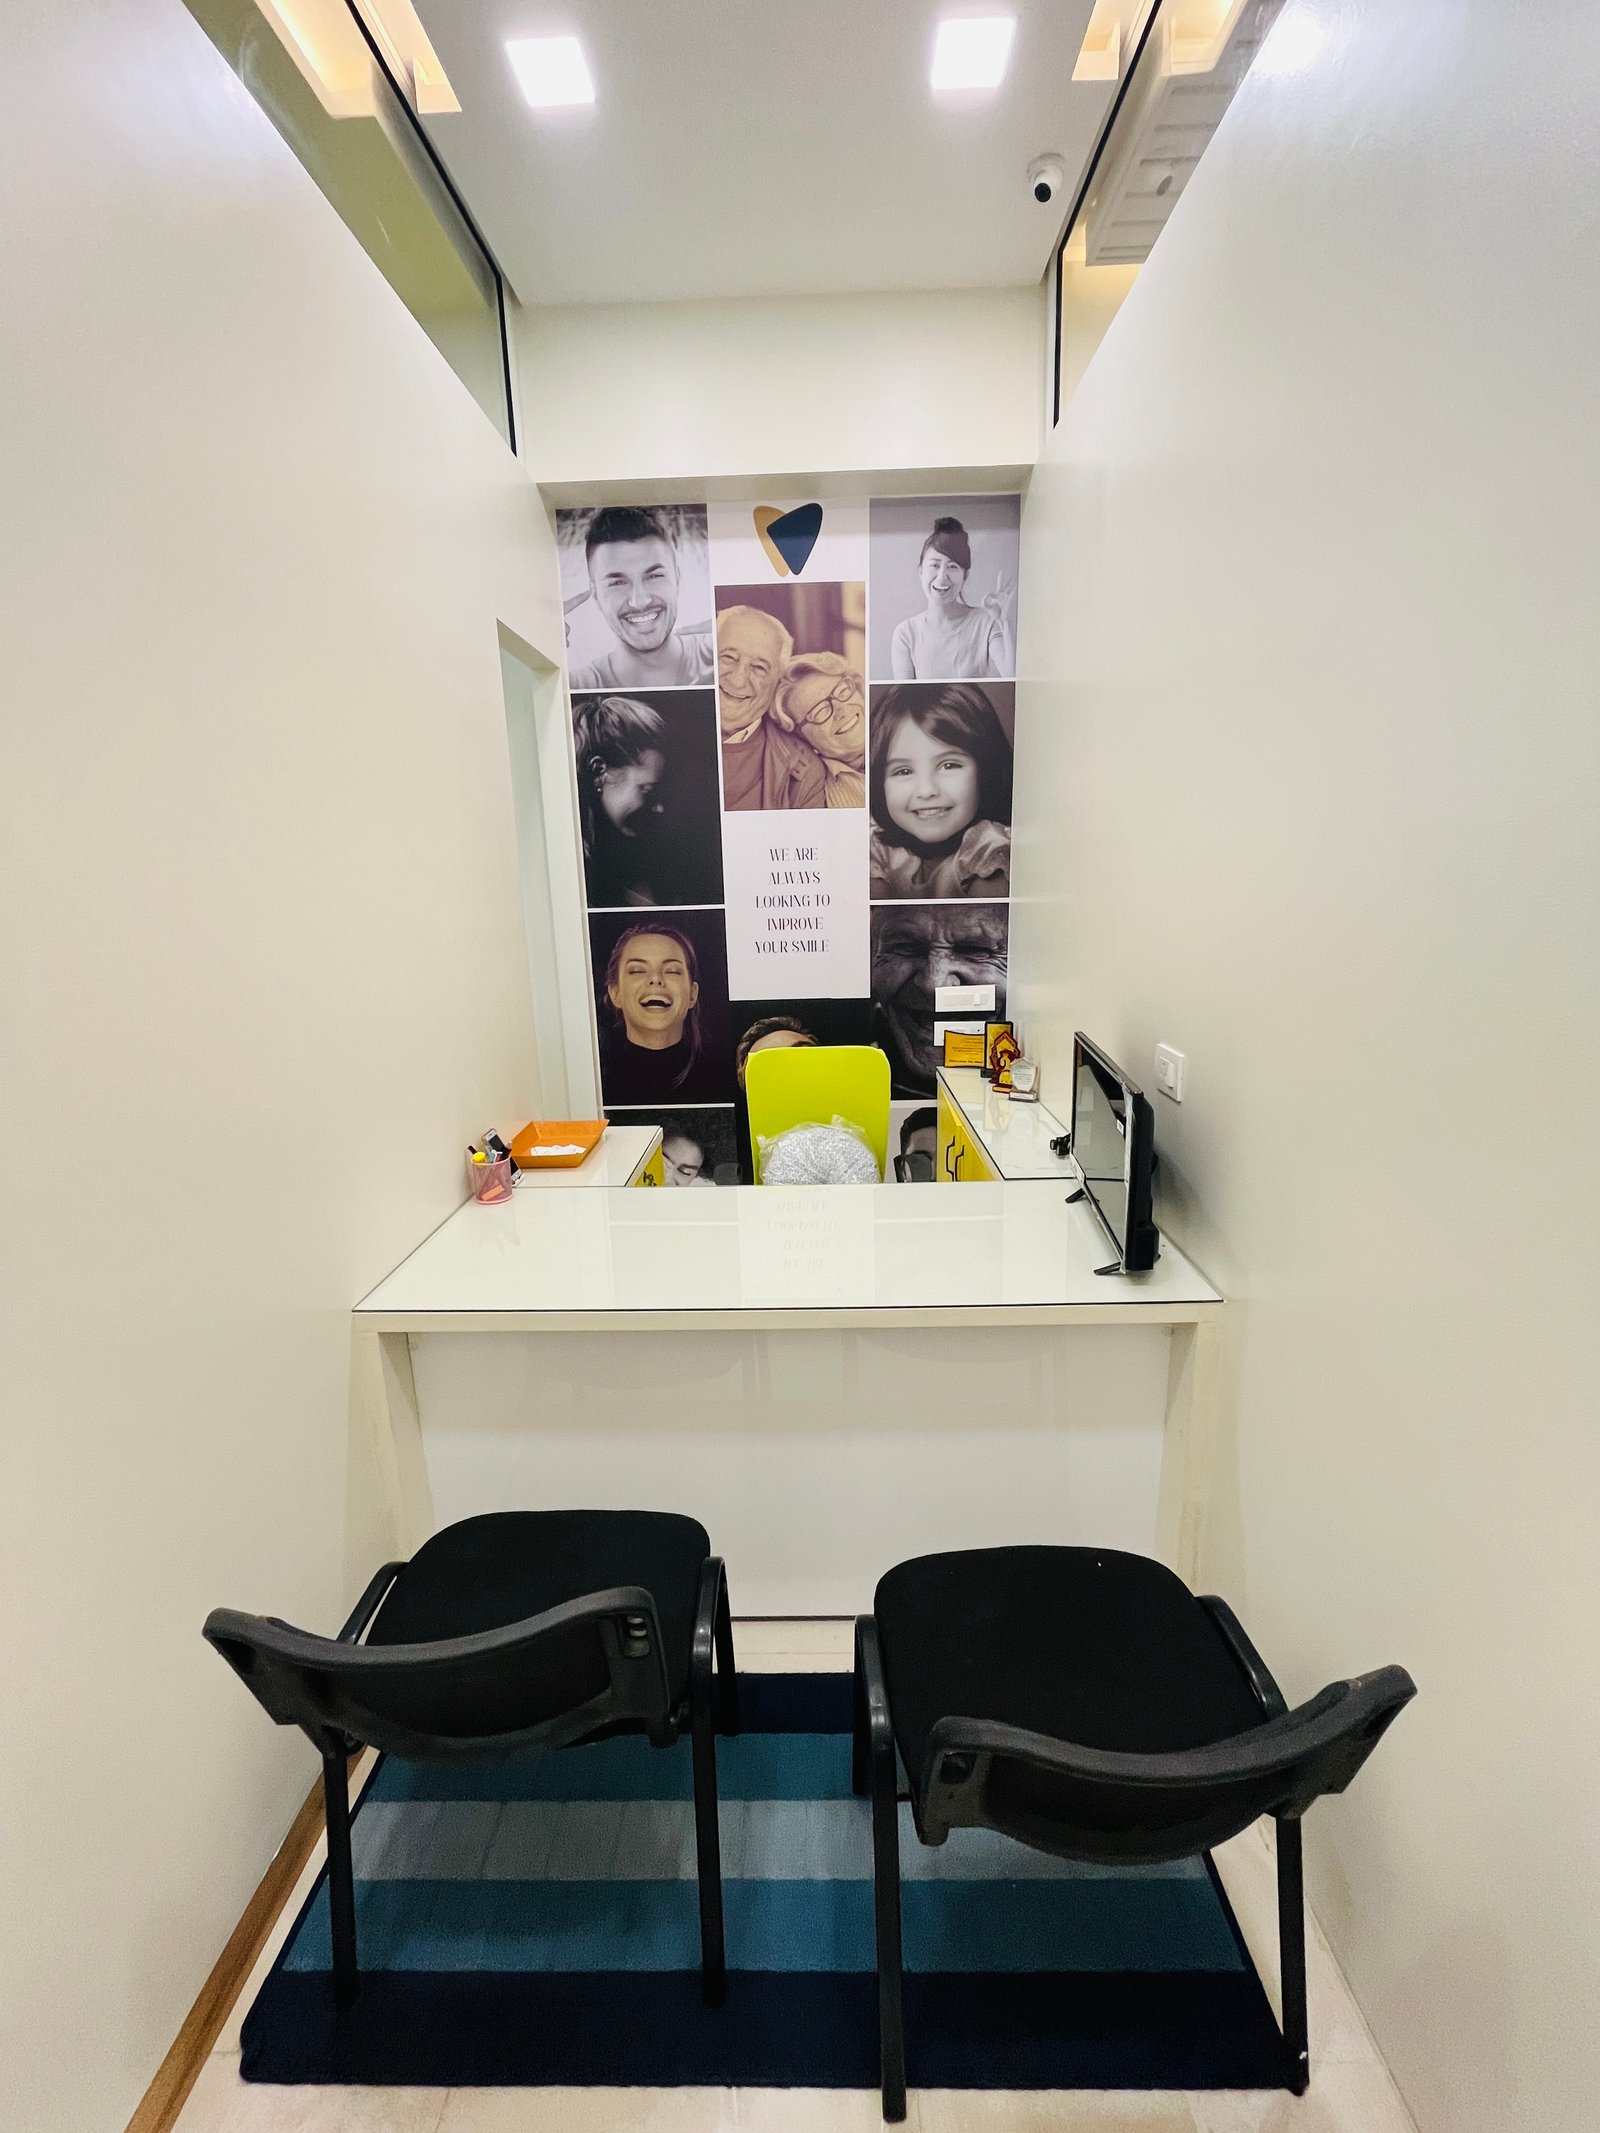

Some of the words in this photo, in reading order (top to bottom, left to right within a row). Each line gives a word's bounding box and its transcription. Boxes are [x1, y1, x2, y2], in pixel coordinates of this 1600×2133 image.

[770, 848, 790, 861] WE
[794, 848, 818, 861] ARE
[769, 871, 821, 885] ALWAYS
[756, 895, 810, 908] LOOKING
[814, 894, 830, 907] TO
[768, 917, 823, 931] IMPROVE
[755, 941, 788, 953] YOUR
[791, 940, 829, 953] SMILE
